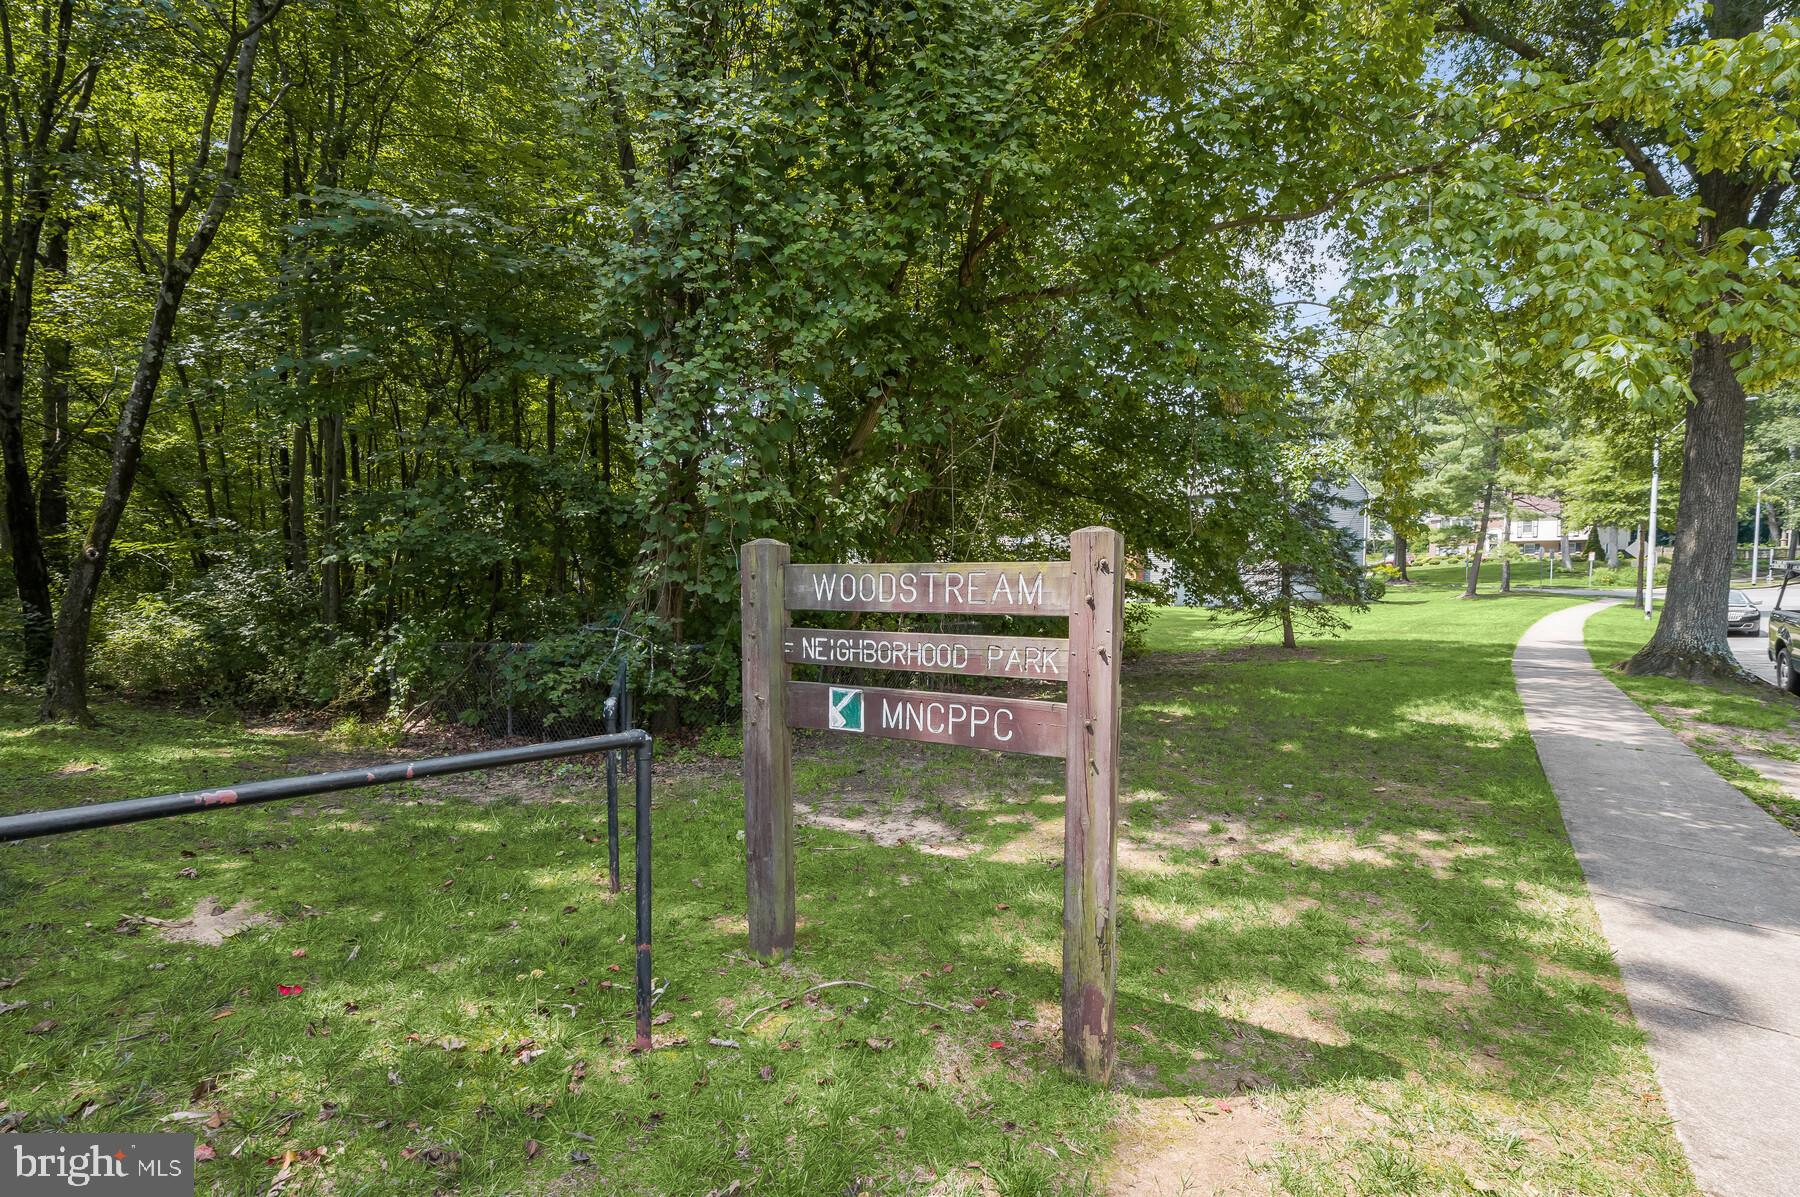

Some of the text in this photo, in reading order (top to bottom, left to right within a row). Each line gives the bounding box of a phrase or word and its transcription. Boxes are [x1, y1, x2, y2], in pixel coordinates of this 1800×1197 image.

[812, 572, 1044, 606] WOODSTREAM
[802, 637, 1060, 675] NEIGHBORHOOD PARK
[882, 698, 1014, 742] MNCPPC
